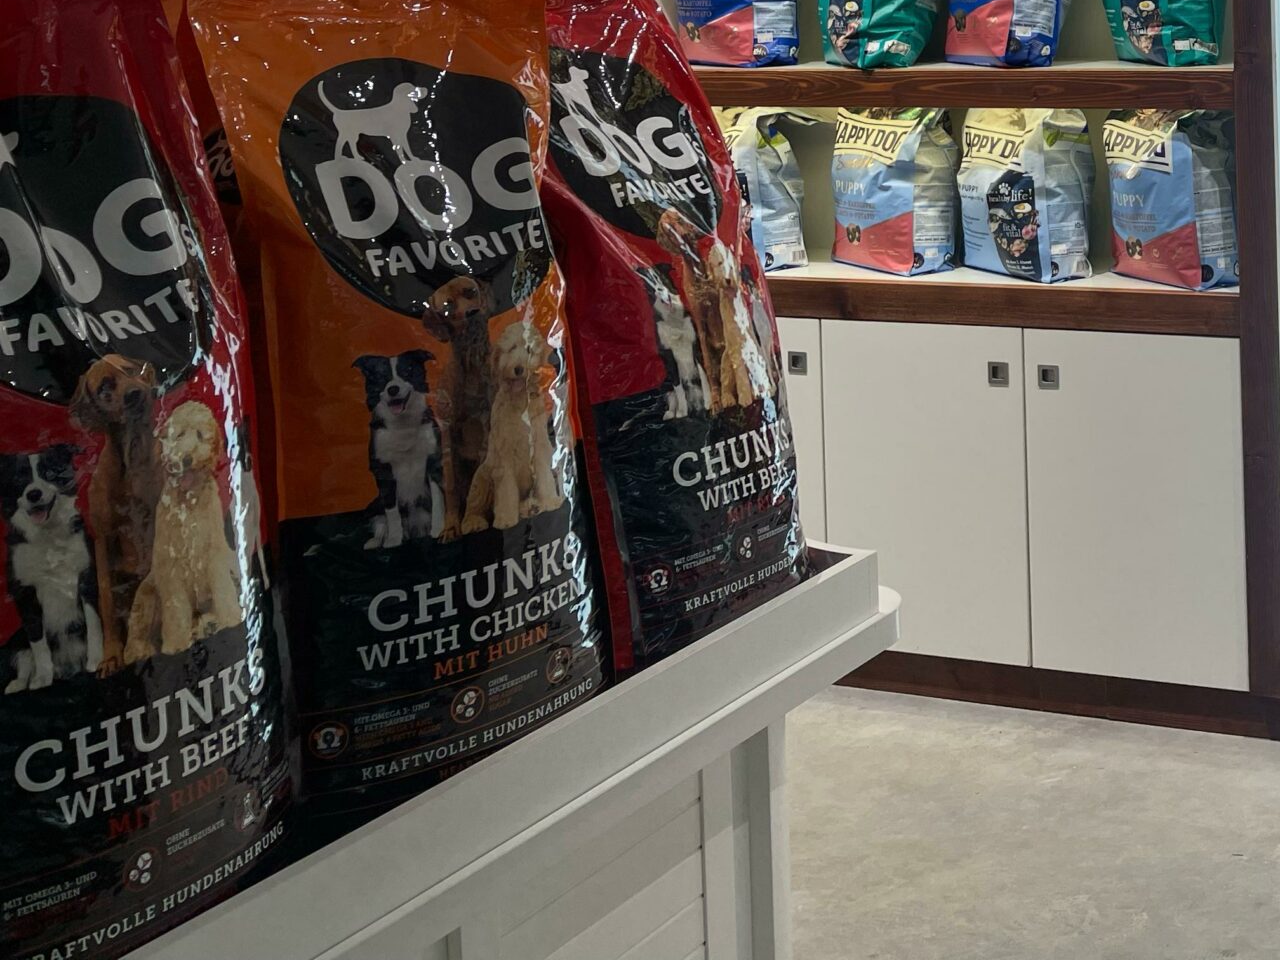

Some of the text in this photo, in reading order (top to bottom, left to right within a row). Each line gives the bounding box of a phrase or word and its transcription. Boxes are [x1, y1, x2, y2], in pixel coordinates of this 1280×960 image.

[315, 137, 541, 240] DOG
[610, 173, 711, 209] FAVORITE
[835, 181, 865, 196] PUPPY
[1011, 188, 1032, 201] life!
[366, 219, 543, 278] FAVORITE
[0, 278, 199, 356] FAVORITE
[673, 418, 791, 487] CHUNKS
[698, 473, 756, 512] WITH
[368, 531, 585, 632] CHUNKS
[685, 573, 755, 612] KRAFTVOLLE
[357, 579, 585, 671] WITH CHICKEN
[433, 624, 548, 680] MIT HUHN
[14, 647, 266, 792] CHUNKS
[362, 735, 478, 781] KRAFTVOLLE
[483, 677, 593, 744] HUNDENAHRUNG
[56, 760, 172, 826] WITH
[108, 766, 231, 839] MIT RIND
[166, 827, 190, 845] OHNE
[25, 884, 62, 905] OMEGA
[76, 871, 97, 885] UND
[30, 905, 156, 960] RAFTVOLLE
[162, 820, 285, 912] HUNDENAHRUNG
